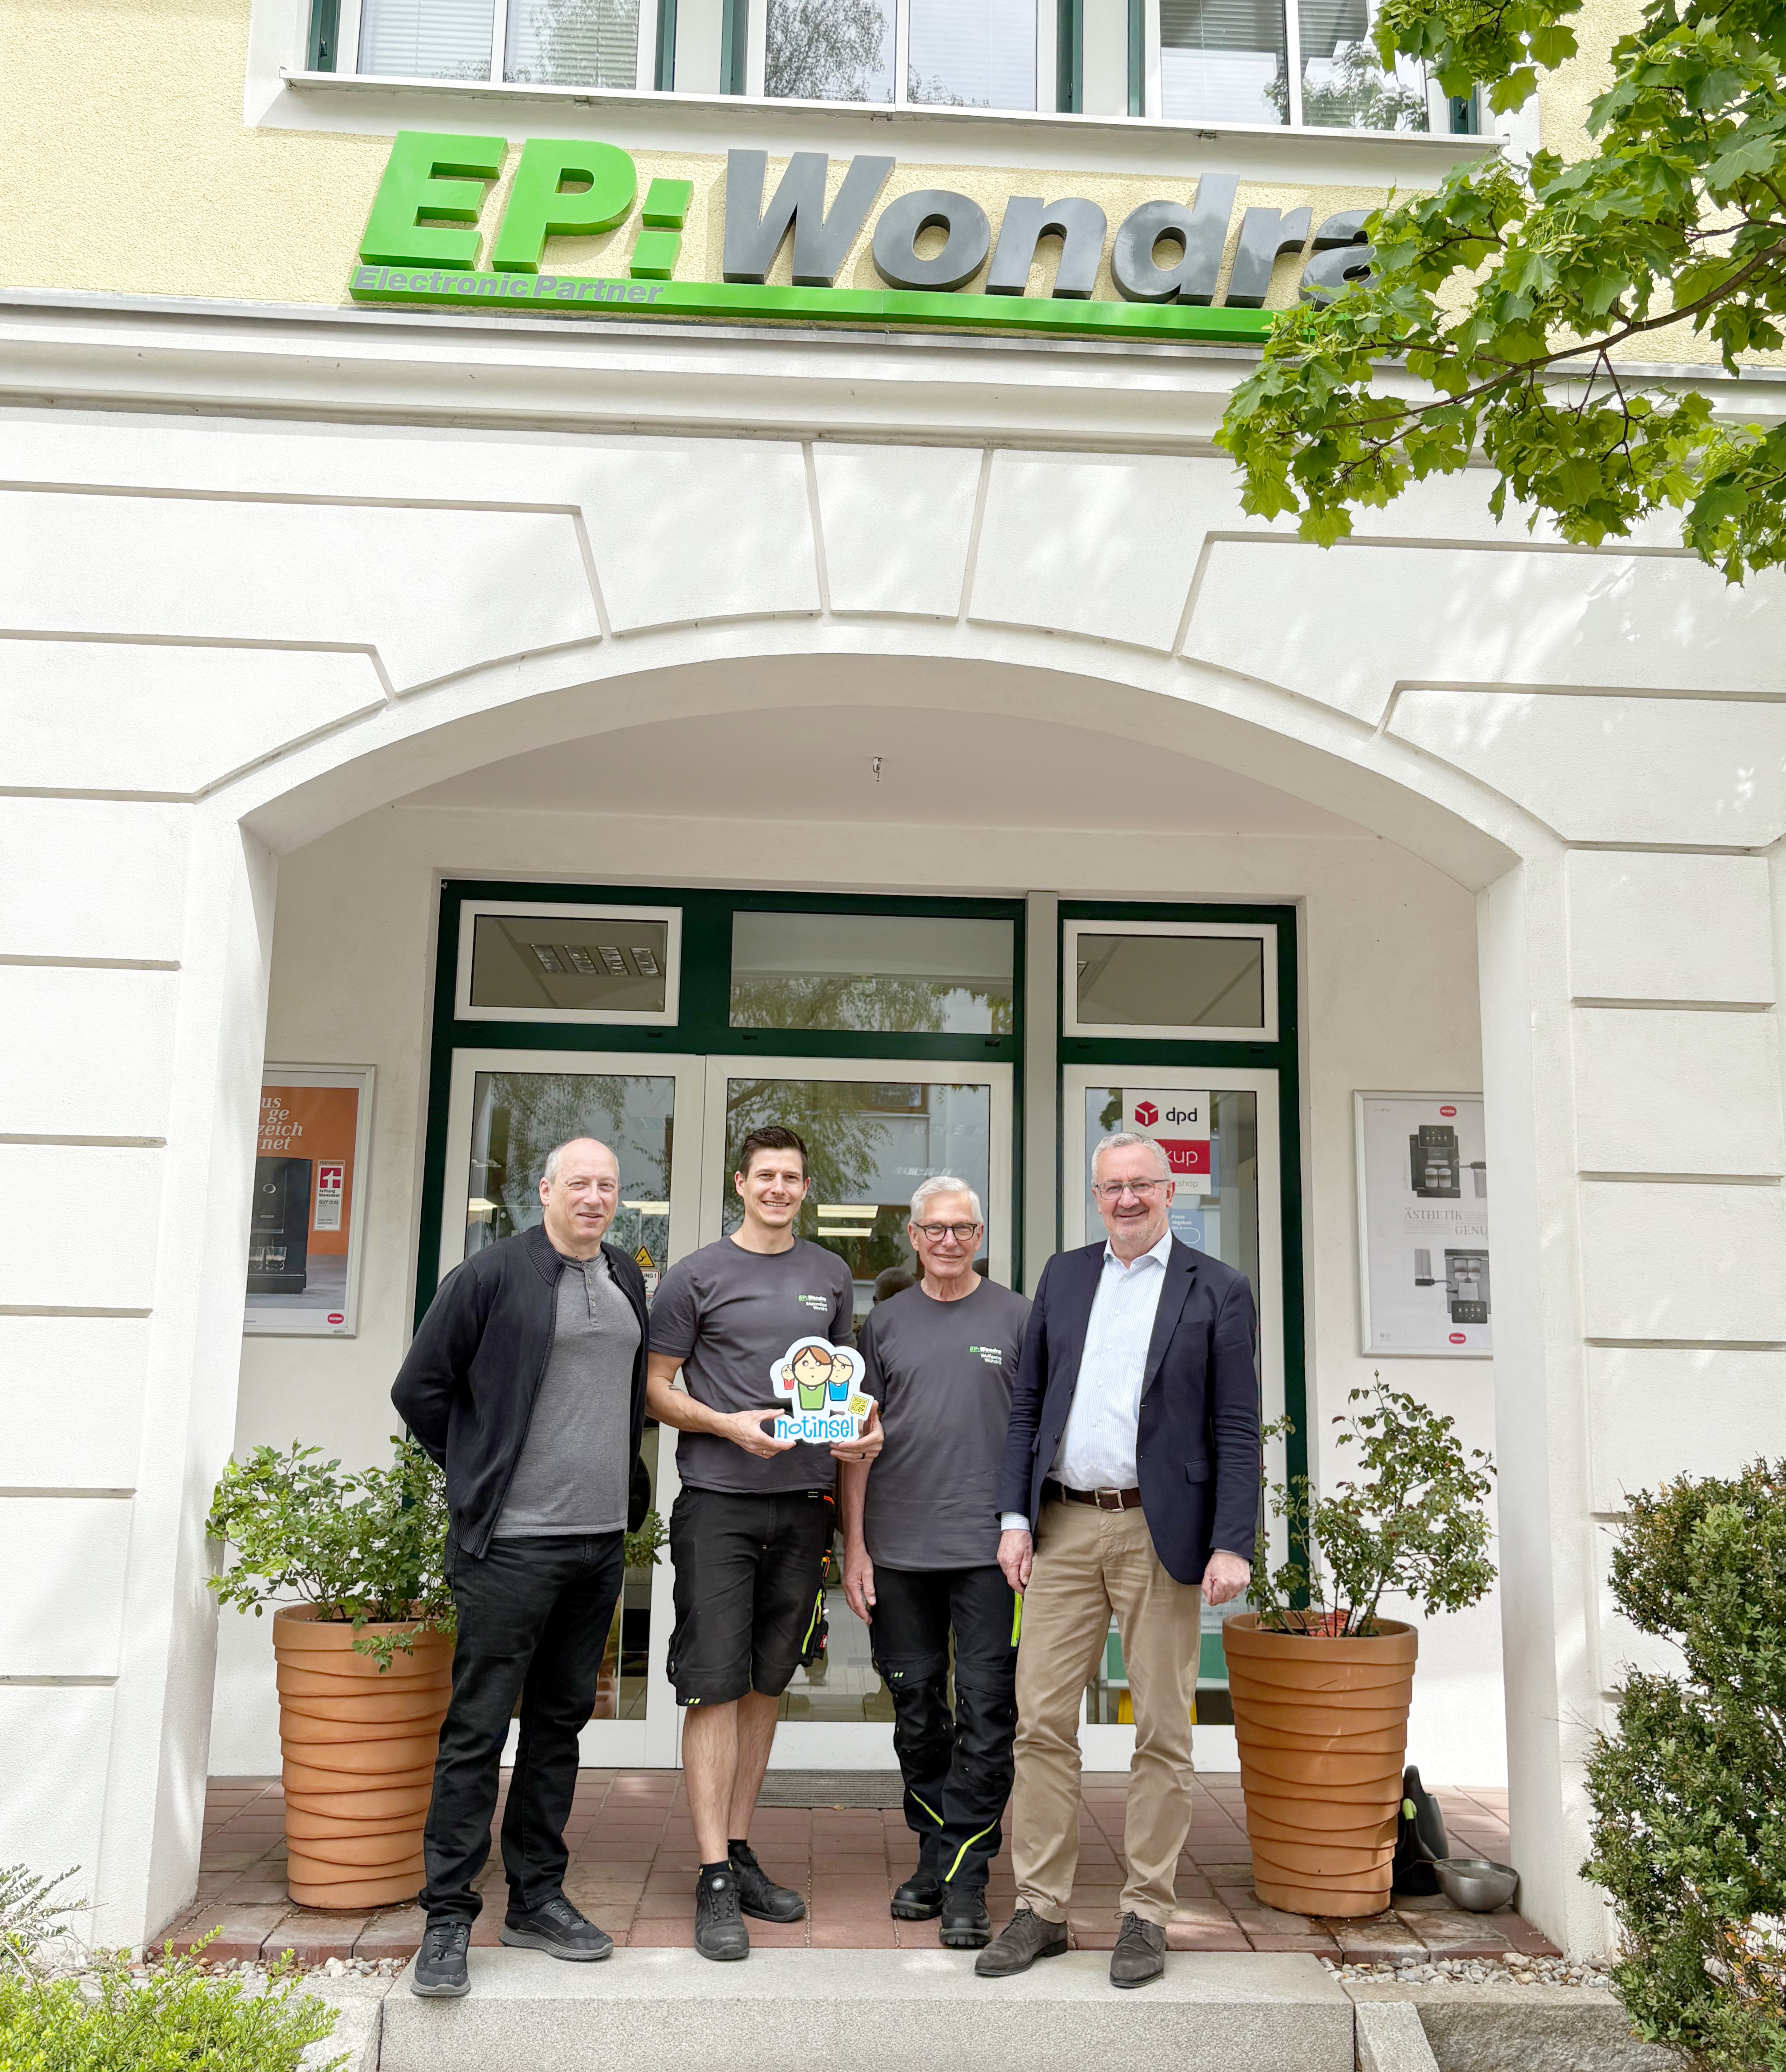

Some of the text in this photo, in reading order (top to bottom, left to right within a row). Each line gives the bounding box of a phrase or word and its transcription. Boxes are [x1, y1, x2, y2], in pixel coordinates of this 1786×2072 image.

[723, 148, 1386, 312] Wondra
[267, 1108, 290, 1124] ge
[1166, 1107, 1197, 1125] dpd
[258, 1121, 303, 1136] zeich
[260, 1136, 292, 1150] net
[777, 1416, 855, 1439] notinsel
